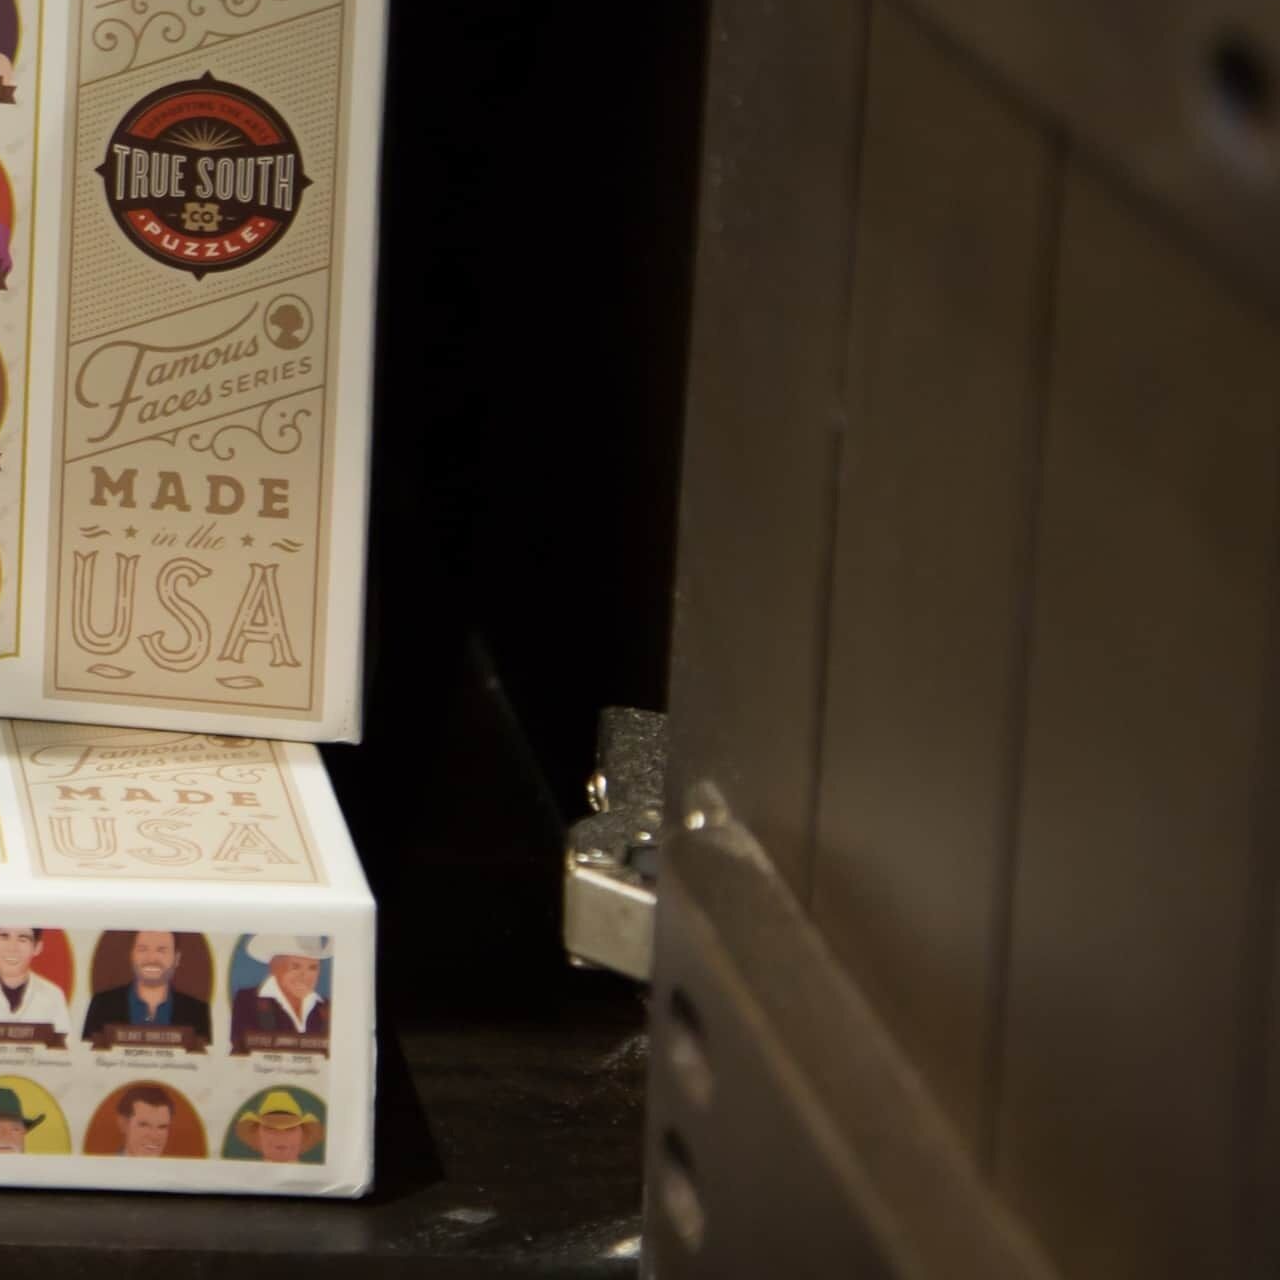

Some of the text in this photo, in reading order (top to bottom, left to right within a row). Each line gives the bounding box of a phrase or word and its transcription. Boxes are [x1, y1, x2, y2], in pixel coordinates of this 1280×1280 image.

[113, 144, 294, 211] TRUE SOUTH
[191, 211, 214, 222] CO
[144, 224, 259, 257] PUZZLE
[220, 356, 312, 398] SERIES
[90, 466, 290, 519] MADE
[151, 521, 225, 551] in the
[72, 551, 301, 672] USA
[56, 785, 261, 807] MADE
[48, 816, 299, 866] USA
